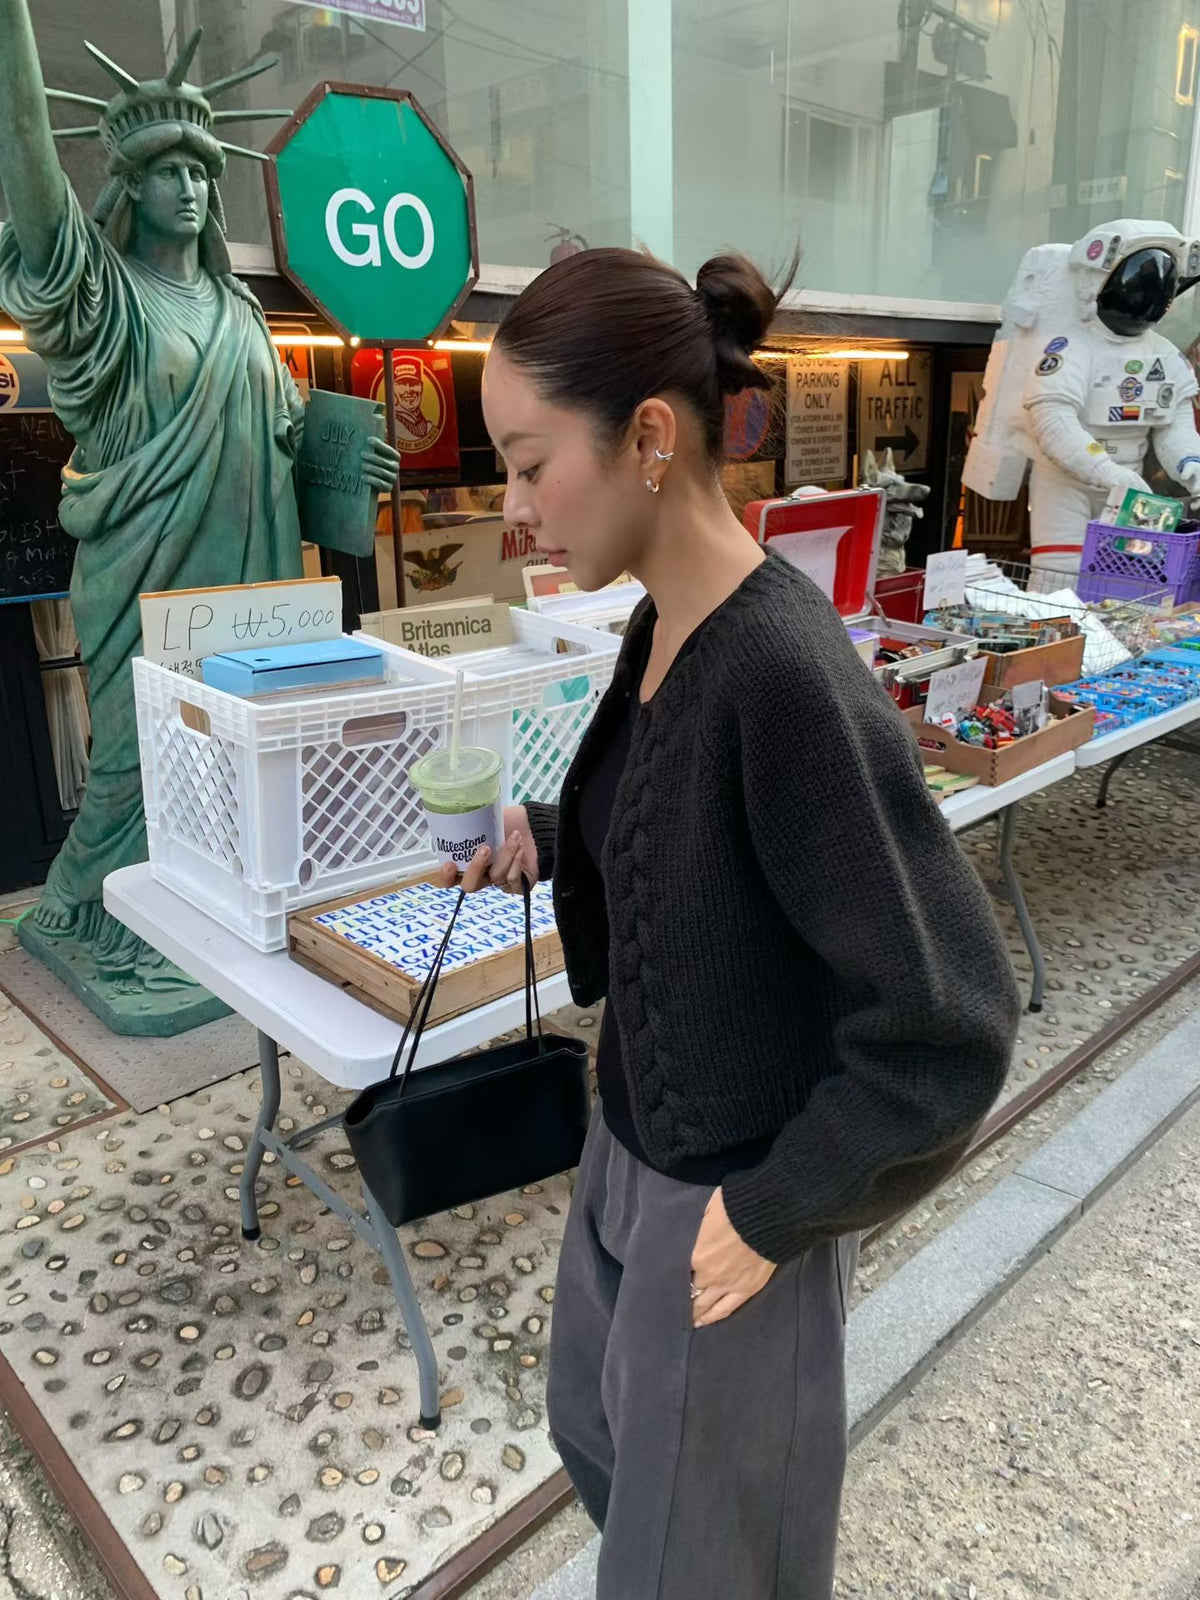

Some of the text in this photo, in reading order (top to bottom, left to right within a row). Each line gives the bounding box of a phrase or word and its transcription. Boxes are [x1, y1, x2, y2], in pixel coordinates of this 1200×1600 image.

[325, 187, 435, 270] GO
[796, 372, 840, 389] PARKING
[879, 359, 917, 388] ALL
[804, 393, 832, 410] ONLY
[866, 396, 923, 421] TRAFFIC
[321, 422, 355, 446] JULY
[163, 603, 334, 651] LP ₩5,000
[401, 615, 492, 642] Britannica
[407, 642, 452, 658] Atlas
[436, 834, 488, 854] Milestone
